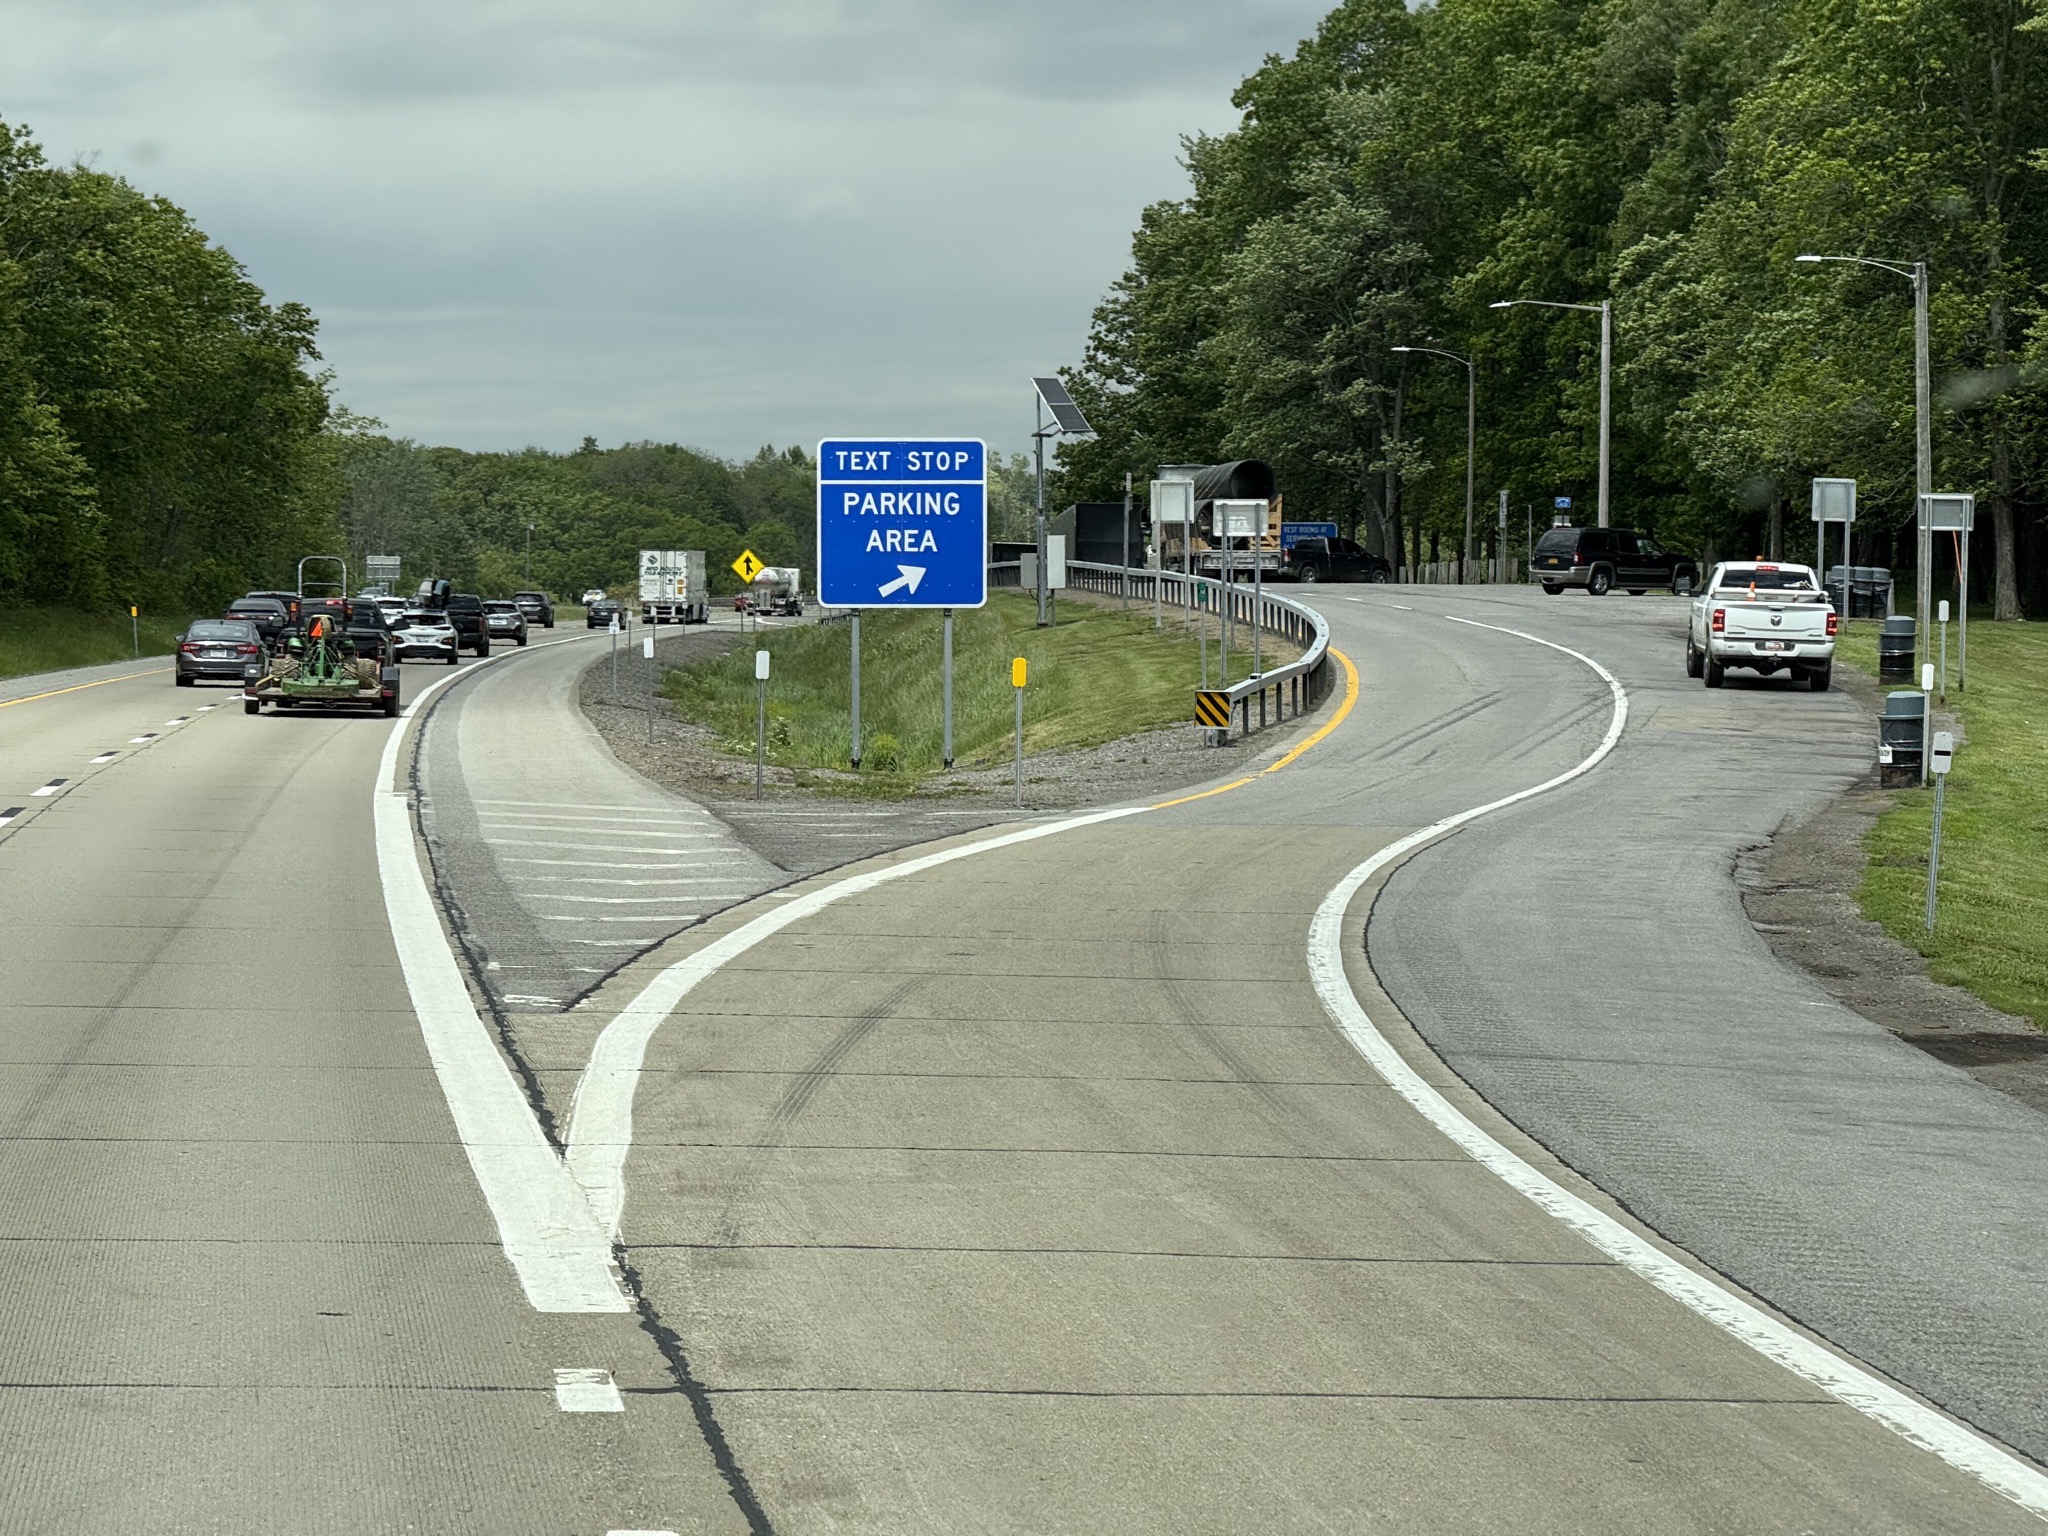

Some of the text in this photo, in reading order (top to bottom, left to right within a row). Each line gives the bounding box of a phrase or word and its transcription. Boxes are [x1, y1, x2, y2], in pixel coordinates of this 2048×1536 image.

[836, 451, 969, 471] TEXT STOP
[843, 492, 960, 516] PARKING
[865, 529, 938, 553] AREA
